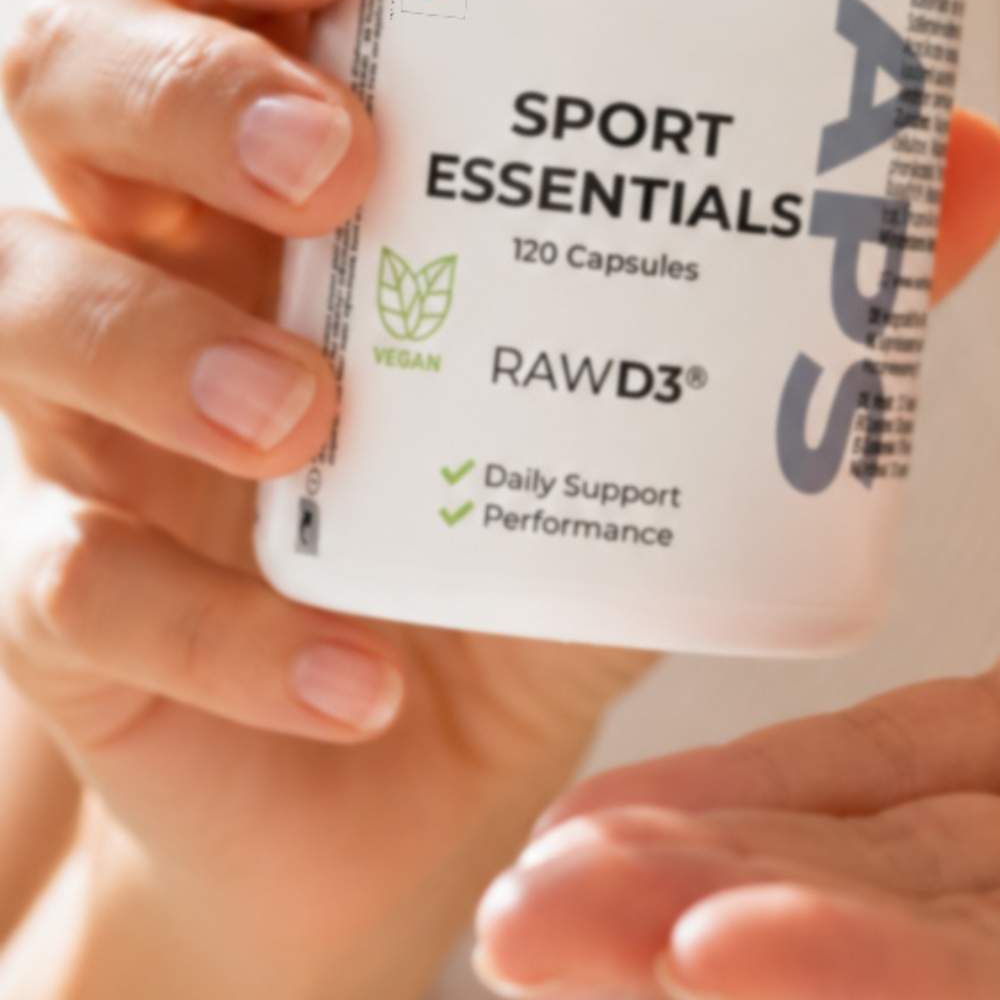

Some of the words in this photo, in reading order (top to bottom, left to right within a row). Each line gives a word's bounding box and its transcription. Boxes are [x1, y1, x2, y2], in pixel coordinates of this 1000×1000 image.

[511, 89, 735, 159] SPORT
[426, 151, 804, 239] ESSENTIALS
[512, 236, 559, 266] 120
[565, 243, 700, 282] Capsules
[373, 346, 442, 373] VEGAN
[483, 462, 557, 498] Daily
[563, 473, 682, 509] Support
[483, 502, 674, 547] Performance
